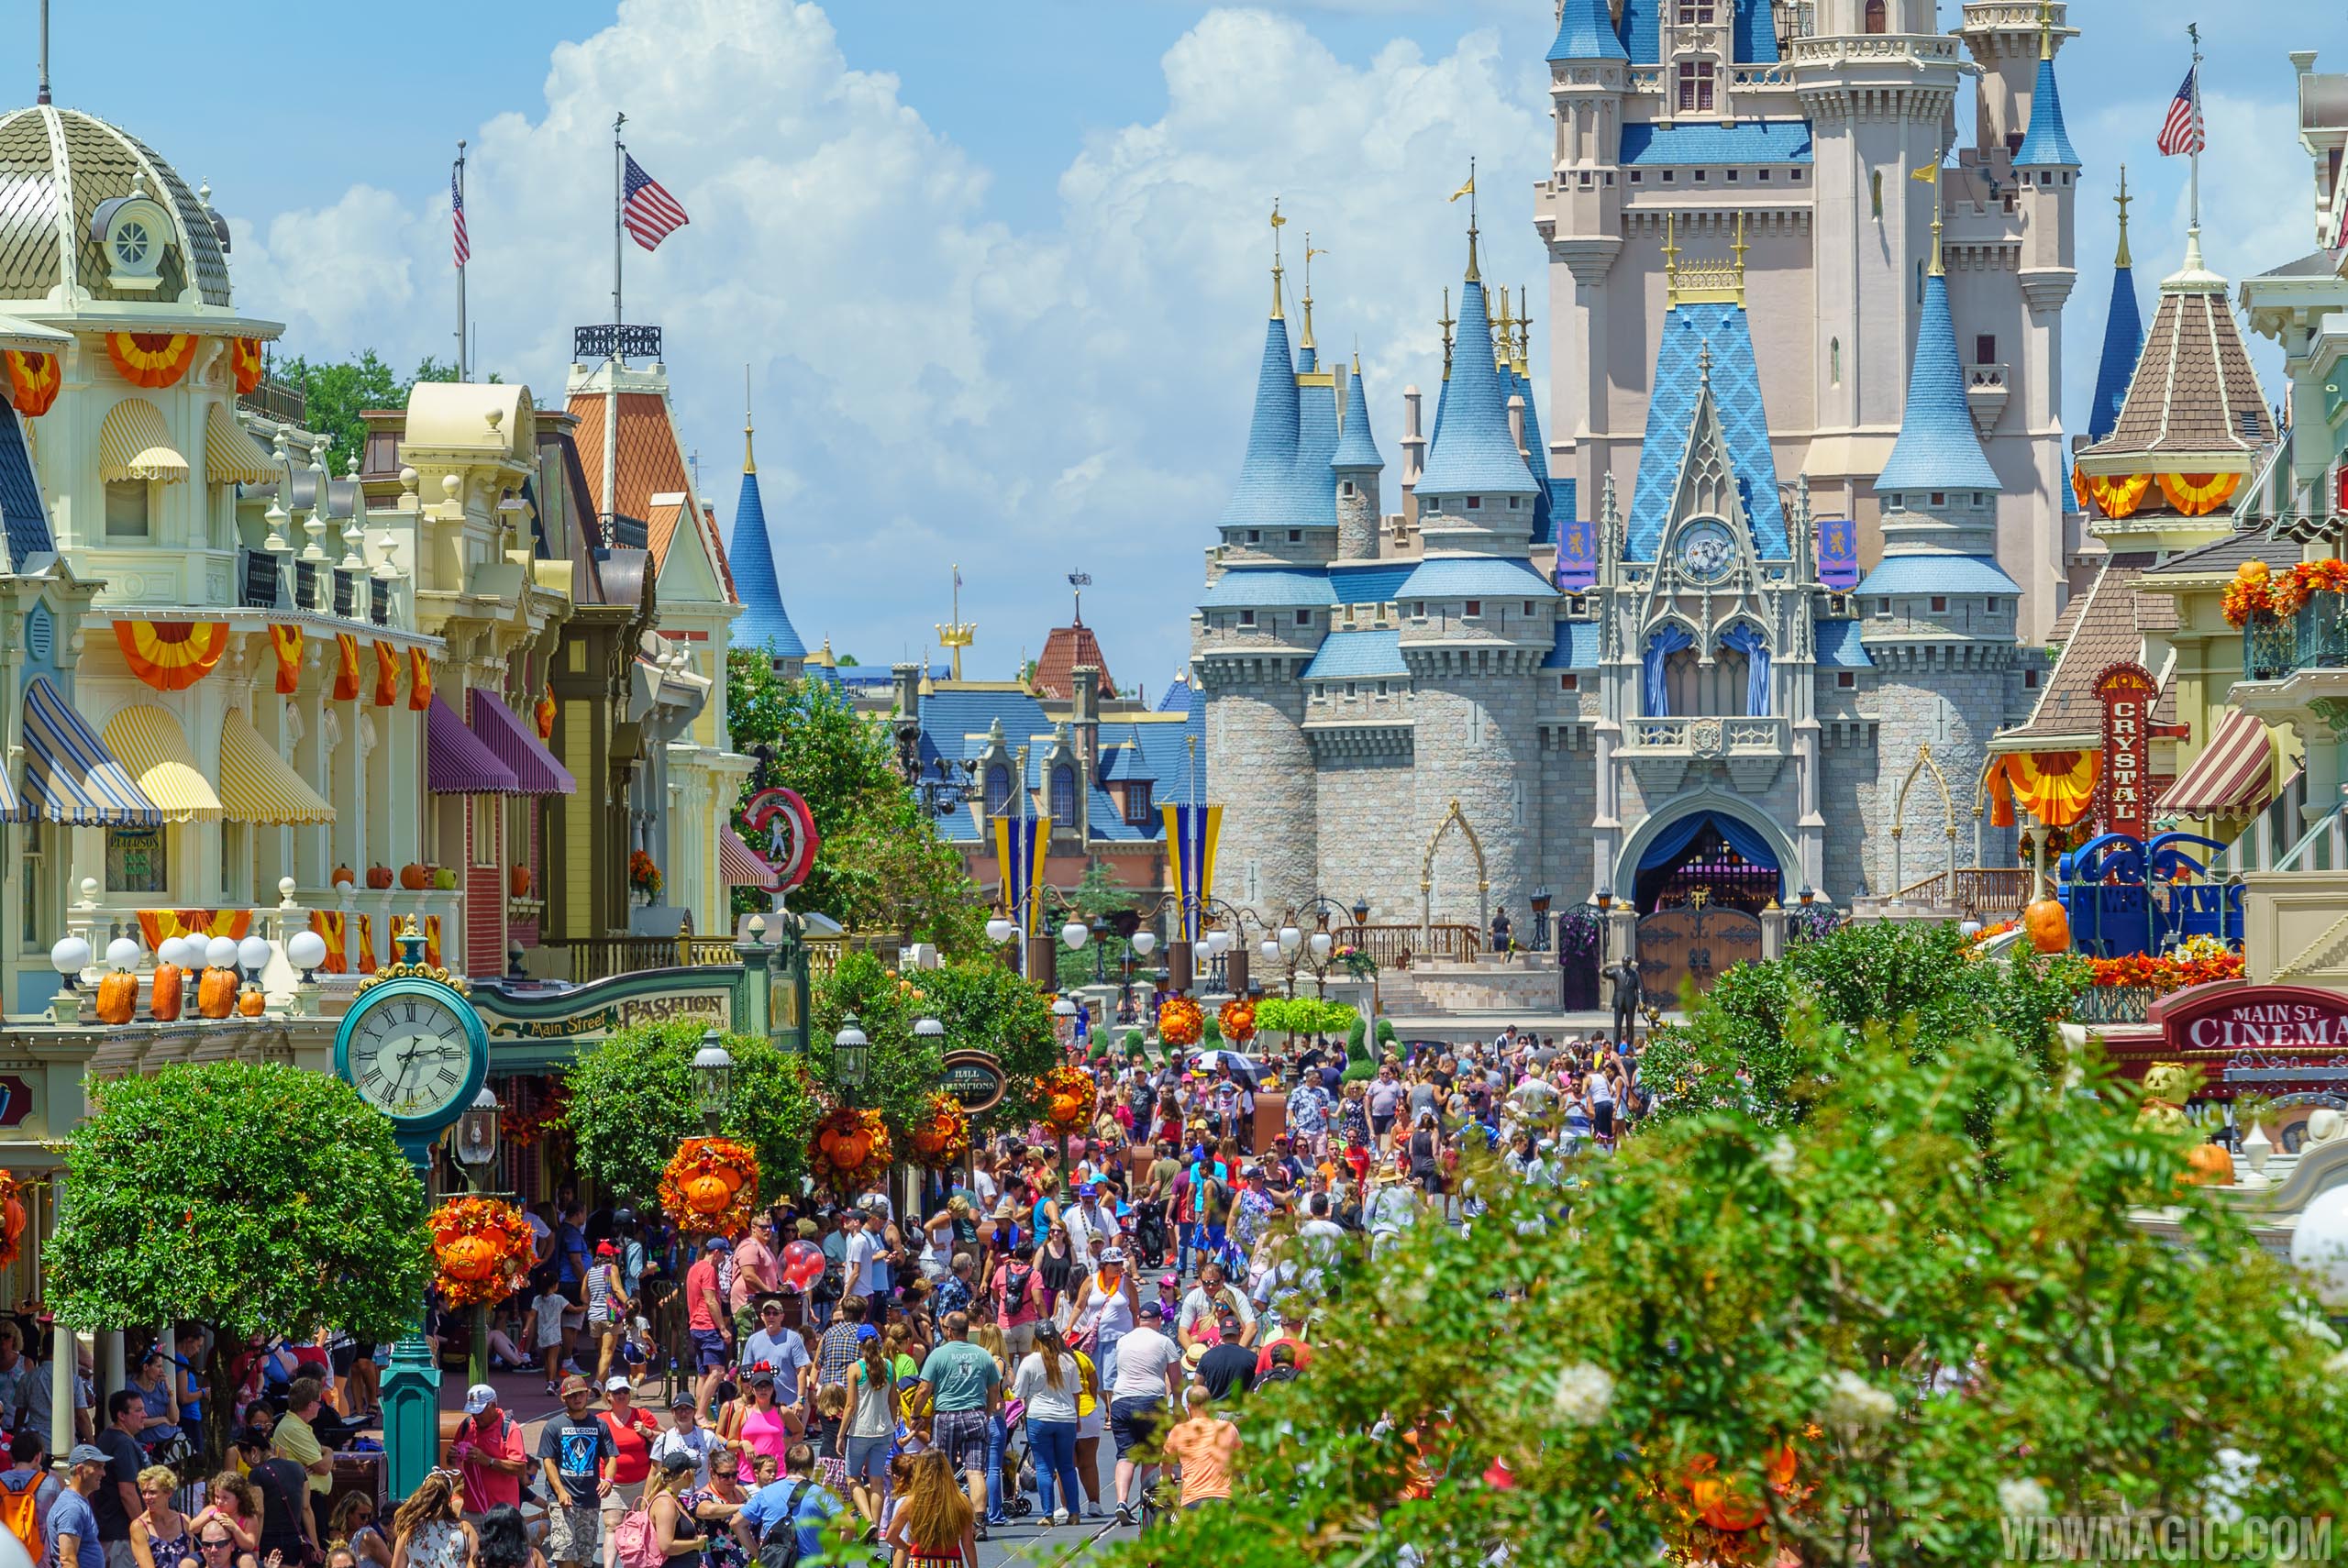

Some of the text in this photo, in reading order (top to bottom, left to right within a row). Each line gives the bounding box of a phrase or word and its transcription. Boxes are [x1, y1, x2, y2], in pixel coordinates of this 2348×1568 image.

[2112, 702, 2138, 819] CRYSTAL
[528, 996, 724, 1039] Main Street FASHION
[2232, 1005, 2322, 1022] MAIN ST.
[955, 1070, 980, 1078] HALL
[951, 1352, 980, 1360] BOOTY
